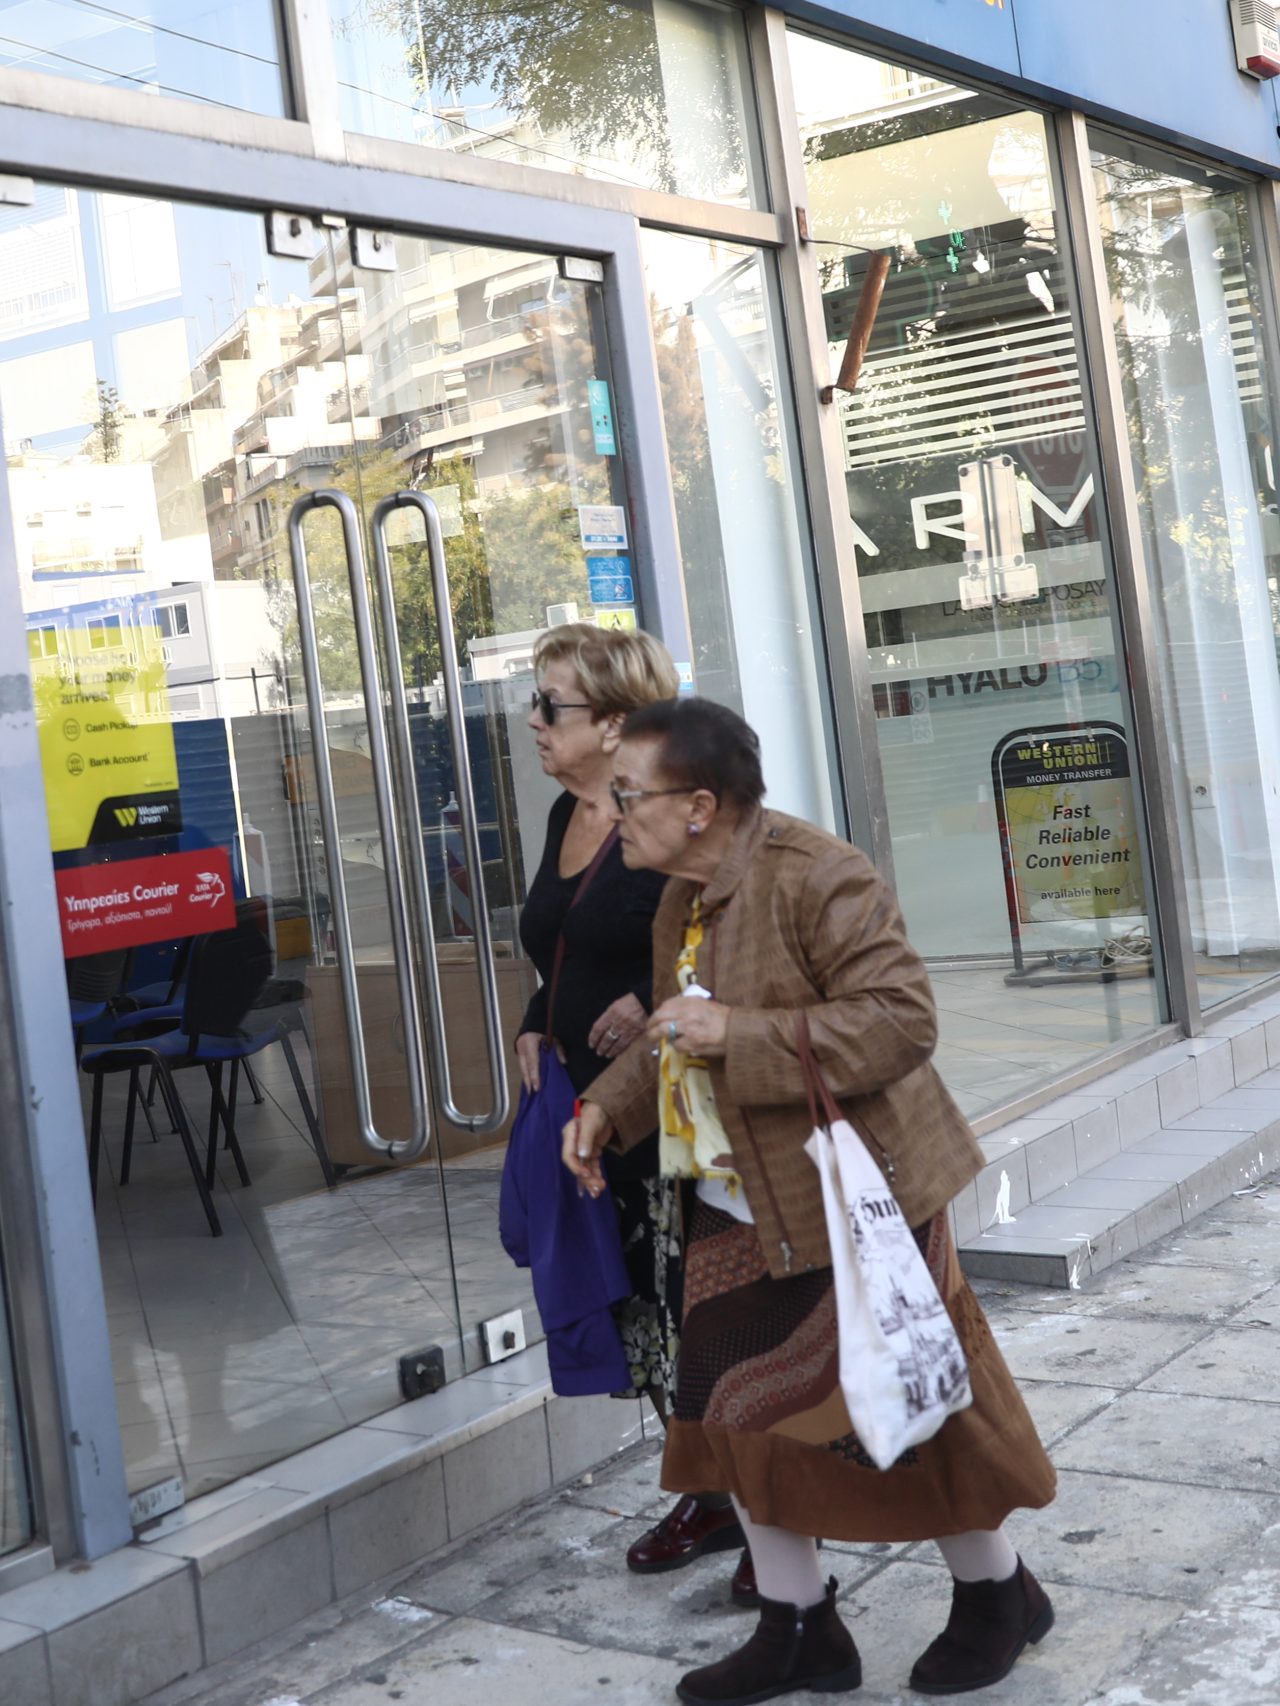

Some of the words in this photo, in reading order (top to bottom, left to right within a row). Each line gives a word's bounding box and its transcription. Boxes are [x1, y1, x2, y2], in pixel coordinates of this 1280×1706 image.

[92, 670, 136, 686] money
[85, 722, 108, 733] Cash
[1017, 743, 1097, 760] WESTERN
[89, 757, 111, 768] Bank
[1042, 754, 1099, 769] UNION
[1026, 773, 1061, 784] MONEY
[1063, 768, 1112, 780] TRANSFER
[138, 805, 169, 815] Western
[1053, 804, 1091, 820] Fast
[139, 815, 162, 825] Union
[1039, 825, 1111, 845] Reliable
[1026, 849, 1131, 869] Convenient
[133, 881, 179, 901] Courier
[189, 892, 213, 903] Courier
[1041, 887, 1091, 900] available
[1094, 885, 1121, 898] here
